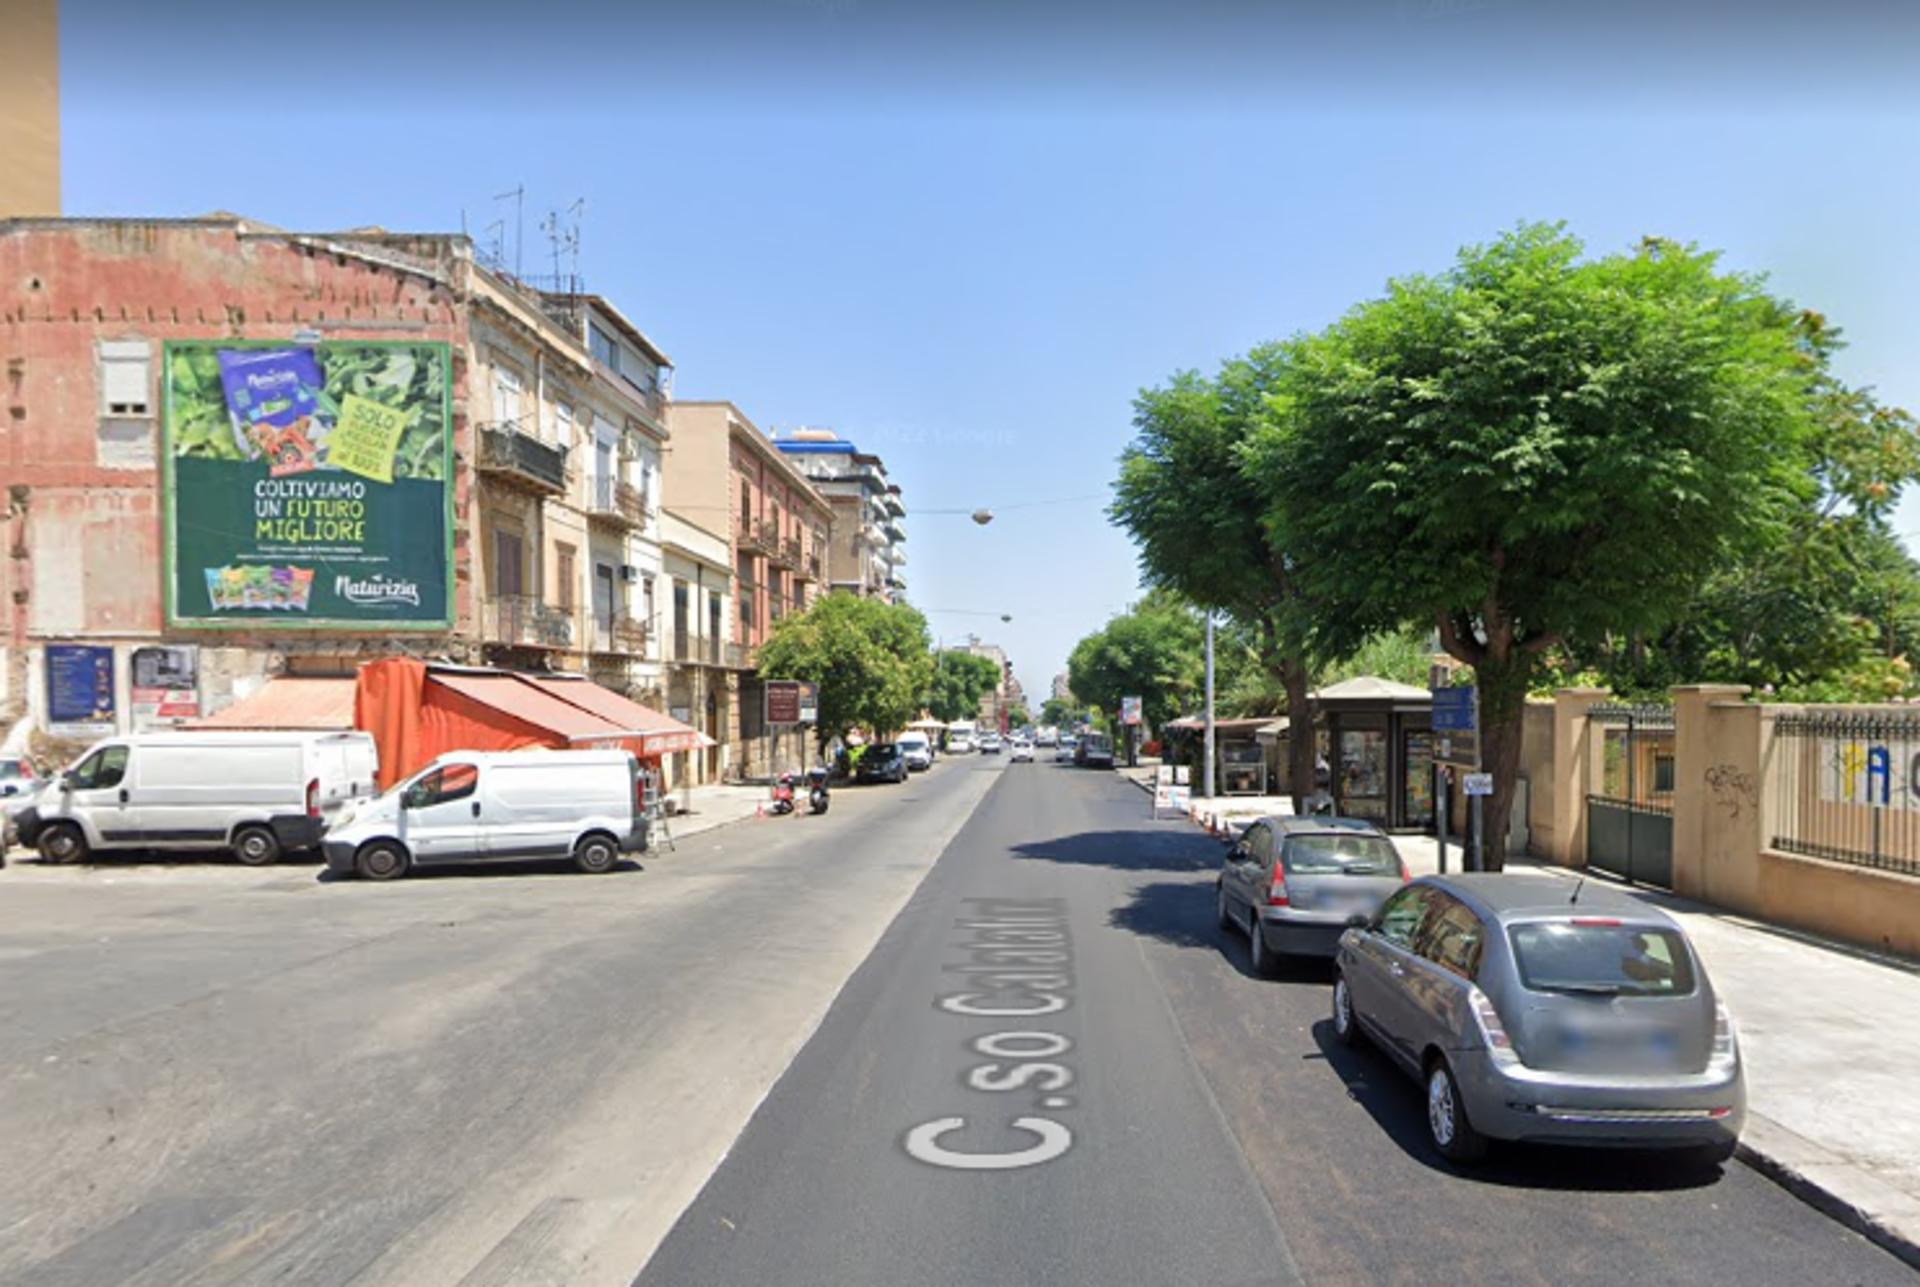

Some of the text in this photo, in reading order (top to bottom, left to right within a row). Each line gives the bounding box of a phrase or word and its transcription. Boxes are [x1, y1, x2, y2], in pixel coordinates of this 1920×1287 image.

[352, 403, 396, 431] SOLO
[254, 480, 366, 499] COLTIVIAMO
[255, 500, 364, 519] UN FUTURO
[255, 519, 366, 543] MIGLIORE
[335, 574, 420, 606] Naturizia
